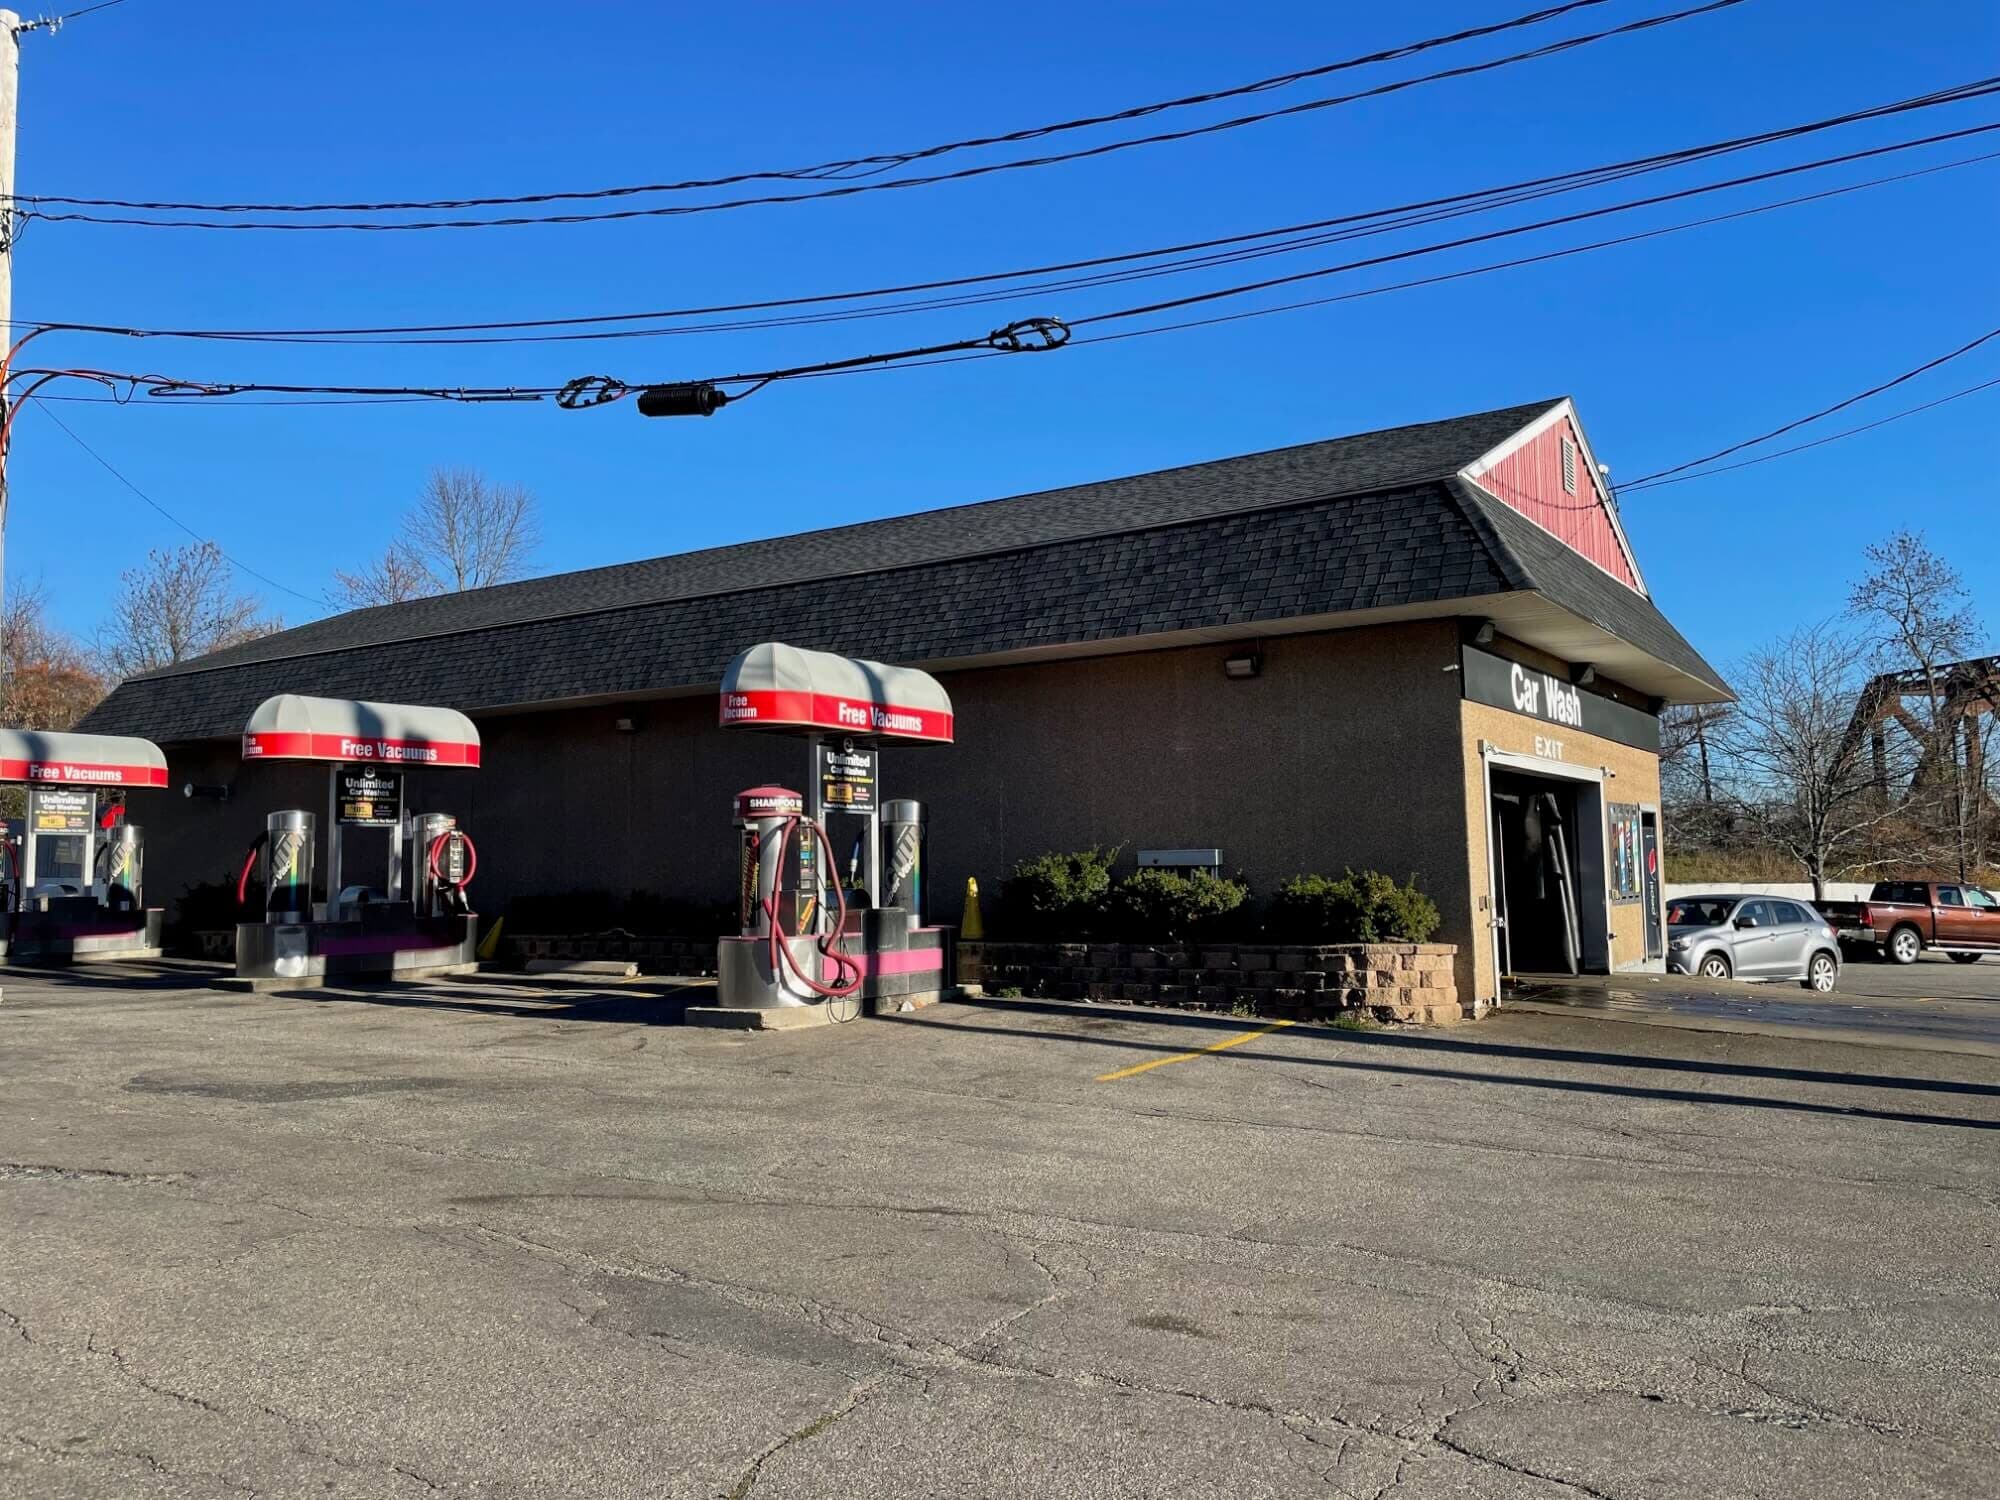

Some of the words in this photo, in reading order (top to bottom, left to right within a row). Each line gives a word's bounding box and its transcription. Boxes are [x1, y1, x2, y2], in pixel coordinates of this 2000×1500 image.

[728, 695, 748, 707] Free
[1511, 663, 1539, 714] Car
[1543, 674, 1582, 727] Wash
[724, 707, 757, 719] Vacuum
[838, 701, 867, 725] Free
[870, 706, 922, 732] Vacuums
[341, 739, 373, 757] Free
[377, 742, 438, 761] Vacuums
[1535, 735, 1564, 760] EXIT
[827, 751, 871, 768] Unlimited
[30, 764, 60, 779] Free
[63, 765, 123, 782] Vacuums
[345, 777, 395, 789] Unlimited
[349, 788, 363, 796] Car
[39, 794, 88, 806] Unlimited
[749, 797, 796, 808] SHAMPOO
